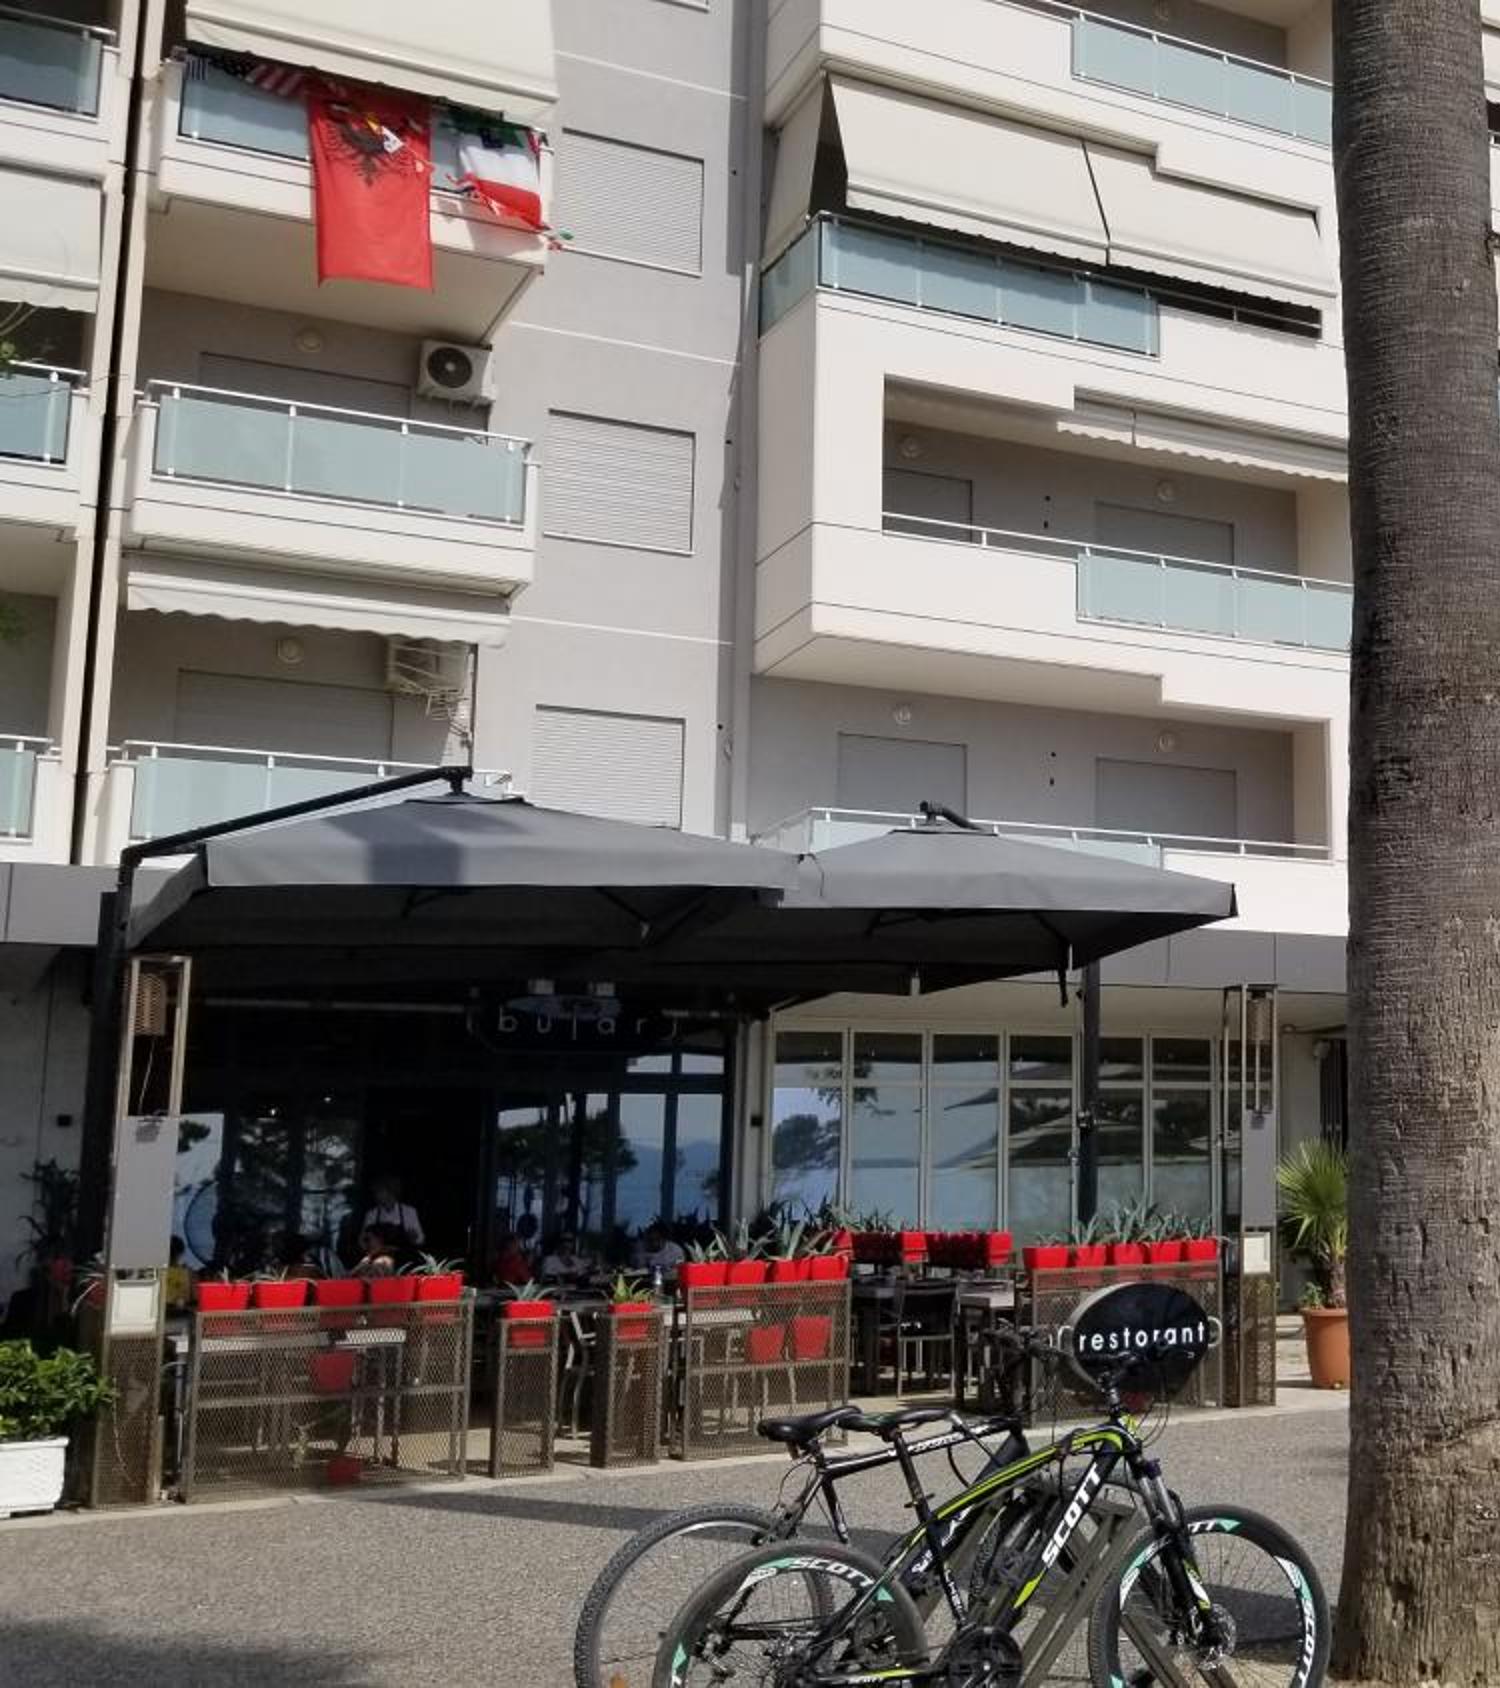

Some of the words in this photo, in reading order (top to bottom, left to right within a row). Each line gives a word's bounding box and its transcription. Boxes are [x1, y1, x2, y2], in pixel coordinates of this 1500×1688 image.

[1078, 1321, 1204, 1352] restorant
[1041, 1461, 1101, 1569] SCOTT
[788, 1556, 877, 1588] SCOTT
[1298, 1598, 1317, 1688] SCOTT
